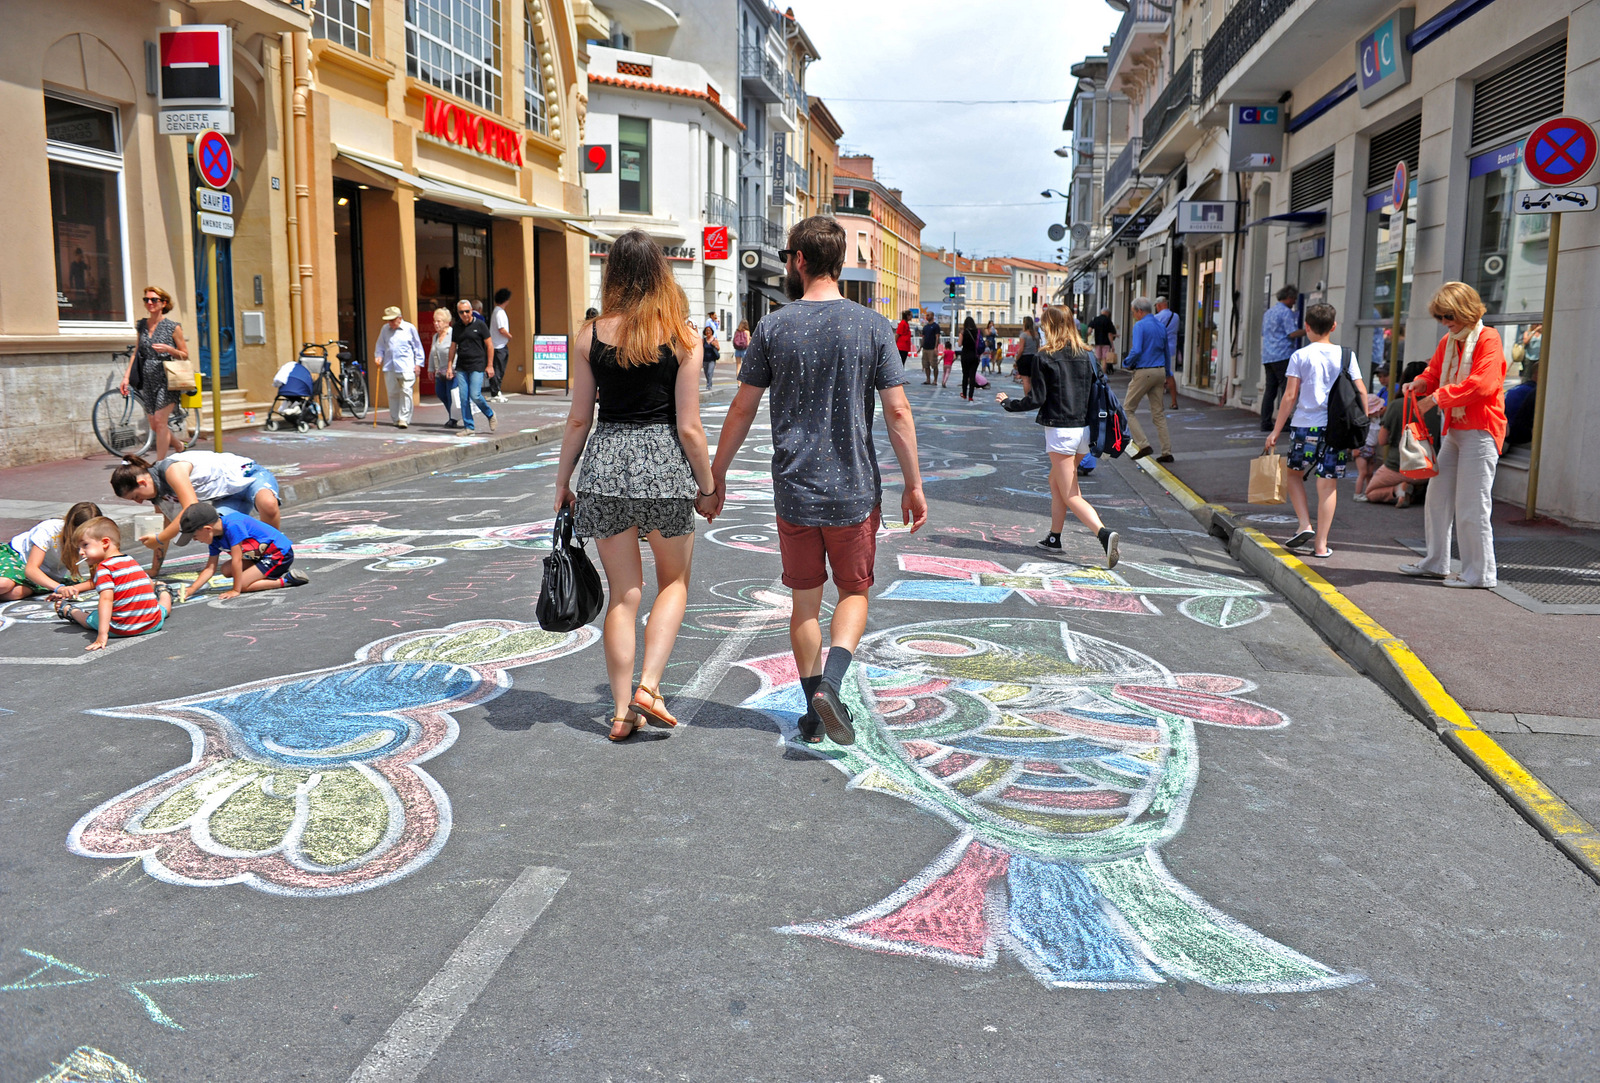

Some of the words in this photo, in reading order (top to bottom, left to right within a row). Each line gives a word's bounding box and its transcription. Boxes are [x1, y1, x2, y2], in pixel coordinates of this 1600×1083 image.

[1363, 32, 1392, 78] CIC
[166, 113, 209, 122] SOCIETE
[1242, 109, 1274, 122] CIC
[424, 94, 523, 167] MONOPRIX
[775, 137, 783, 179] HOTEL
[1497, 152, 1516, 165] Banque
[773, 179, 784, 187] 22
[203, 194, 221, 207] SAUF
[203, 219, 222, 229] AMENDE
